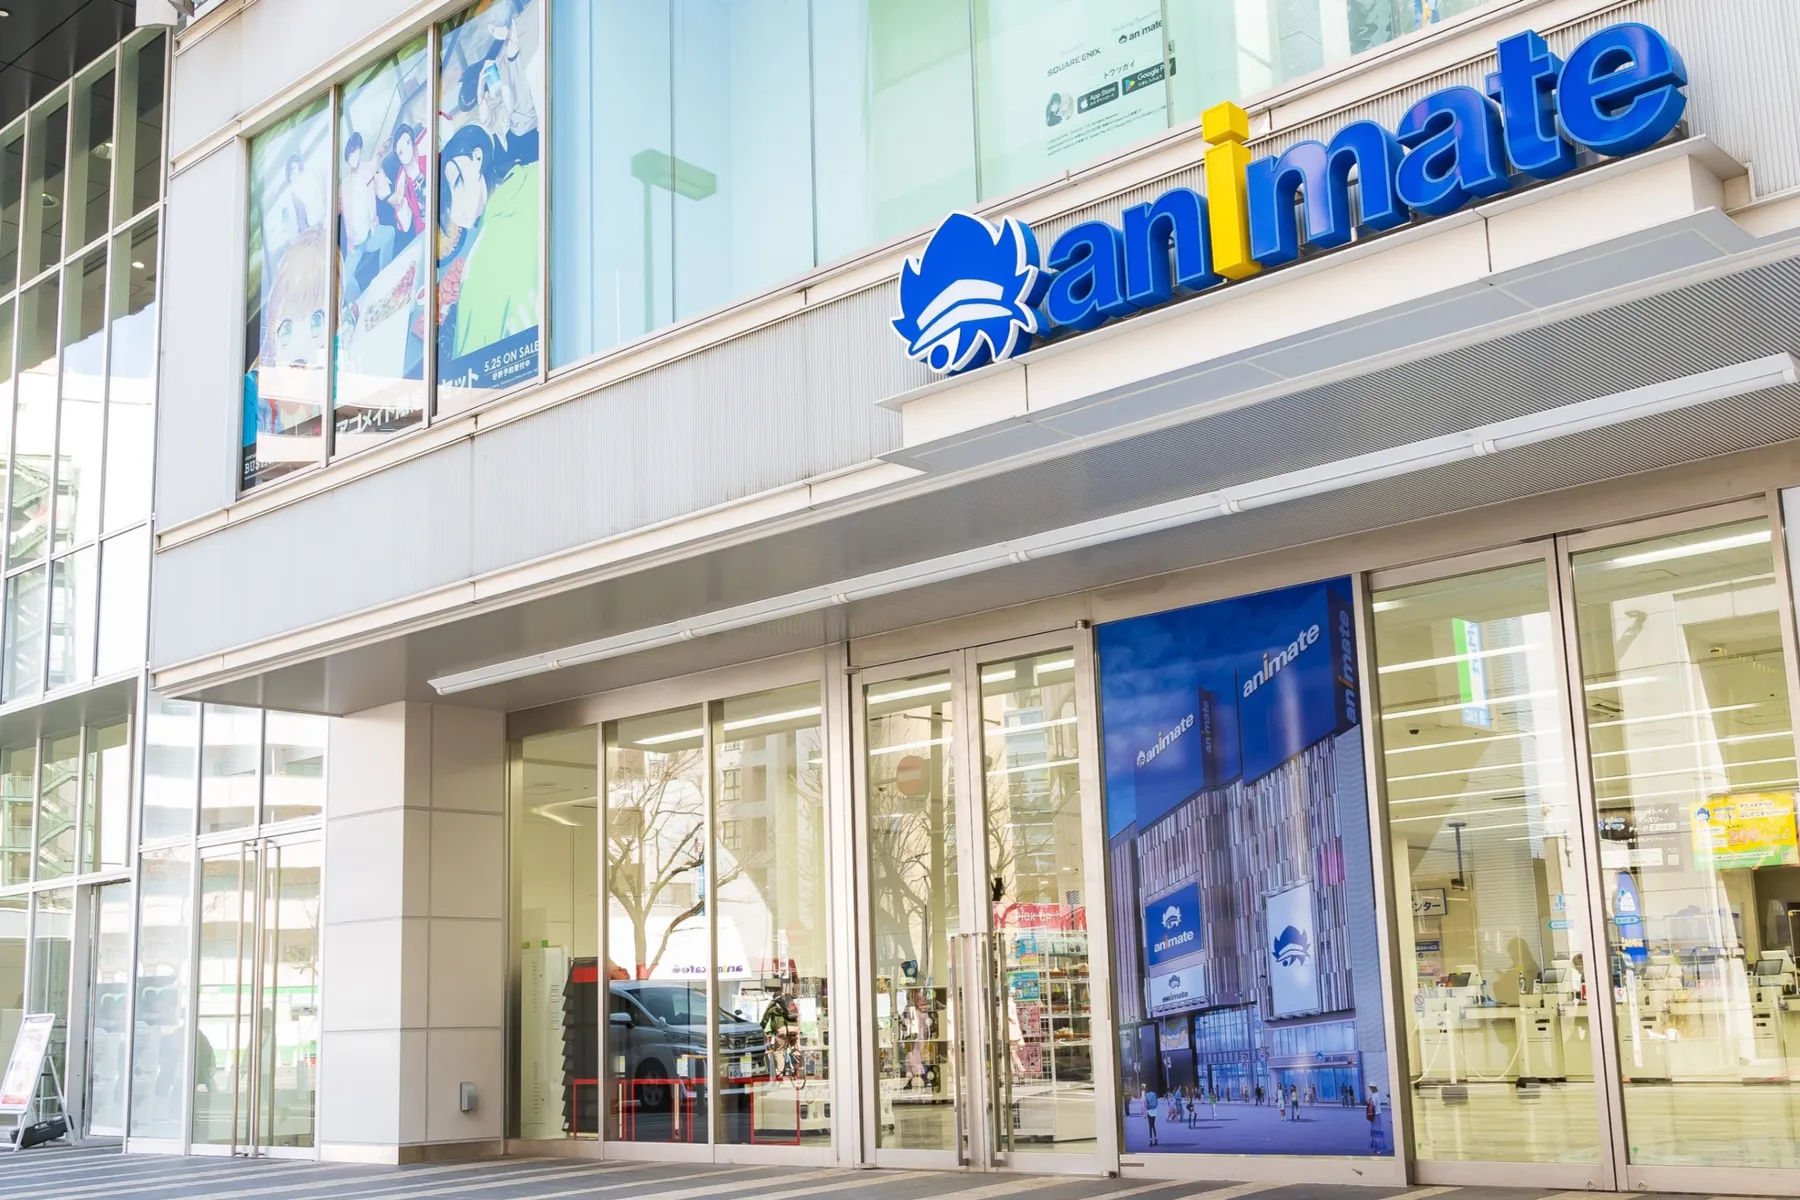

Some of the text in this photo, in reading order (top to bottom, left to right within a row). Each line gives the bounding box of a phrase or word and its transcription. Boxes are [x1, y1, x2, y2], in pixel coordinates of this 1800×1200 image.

[1047, 56, 1081, 77] SQUARE
[1082, 47, 1101, 62] ENIX
[1137, 66, 1160, 81] Google
[1089, 86, 1116, 101] App Store
[1046, 22, 1688, 331] animate
[484, 340, 539, 372] 5.25 ON SALE
[1243, 623, 1320, 698] animate
[1338, 609, 1357, 724] animate
[1145, 713, 1195, 764] animate
[1201, 700, 1212, 754] animate
[1728, 828, 1761, 845] 200
[1154, 930, 1194, 953] animate
